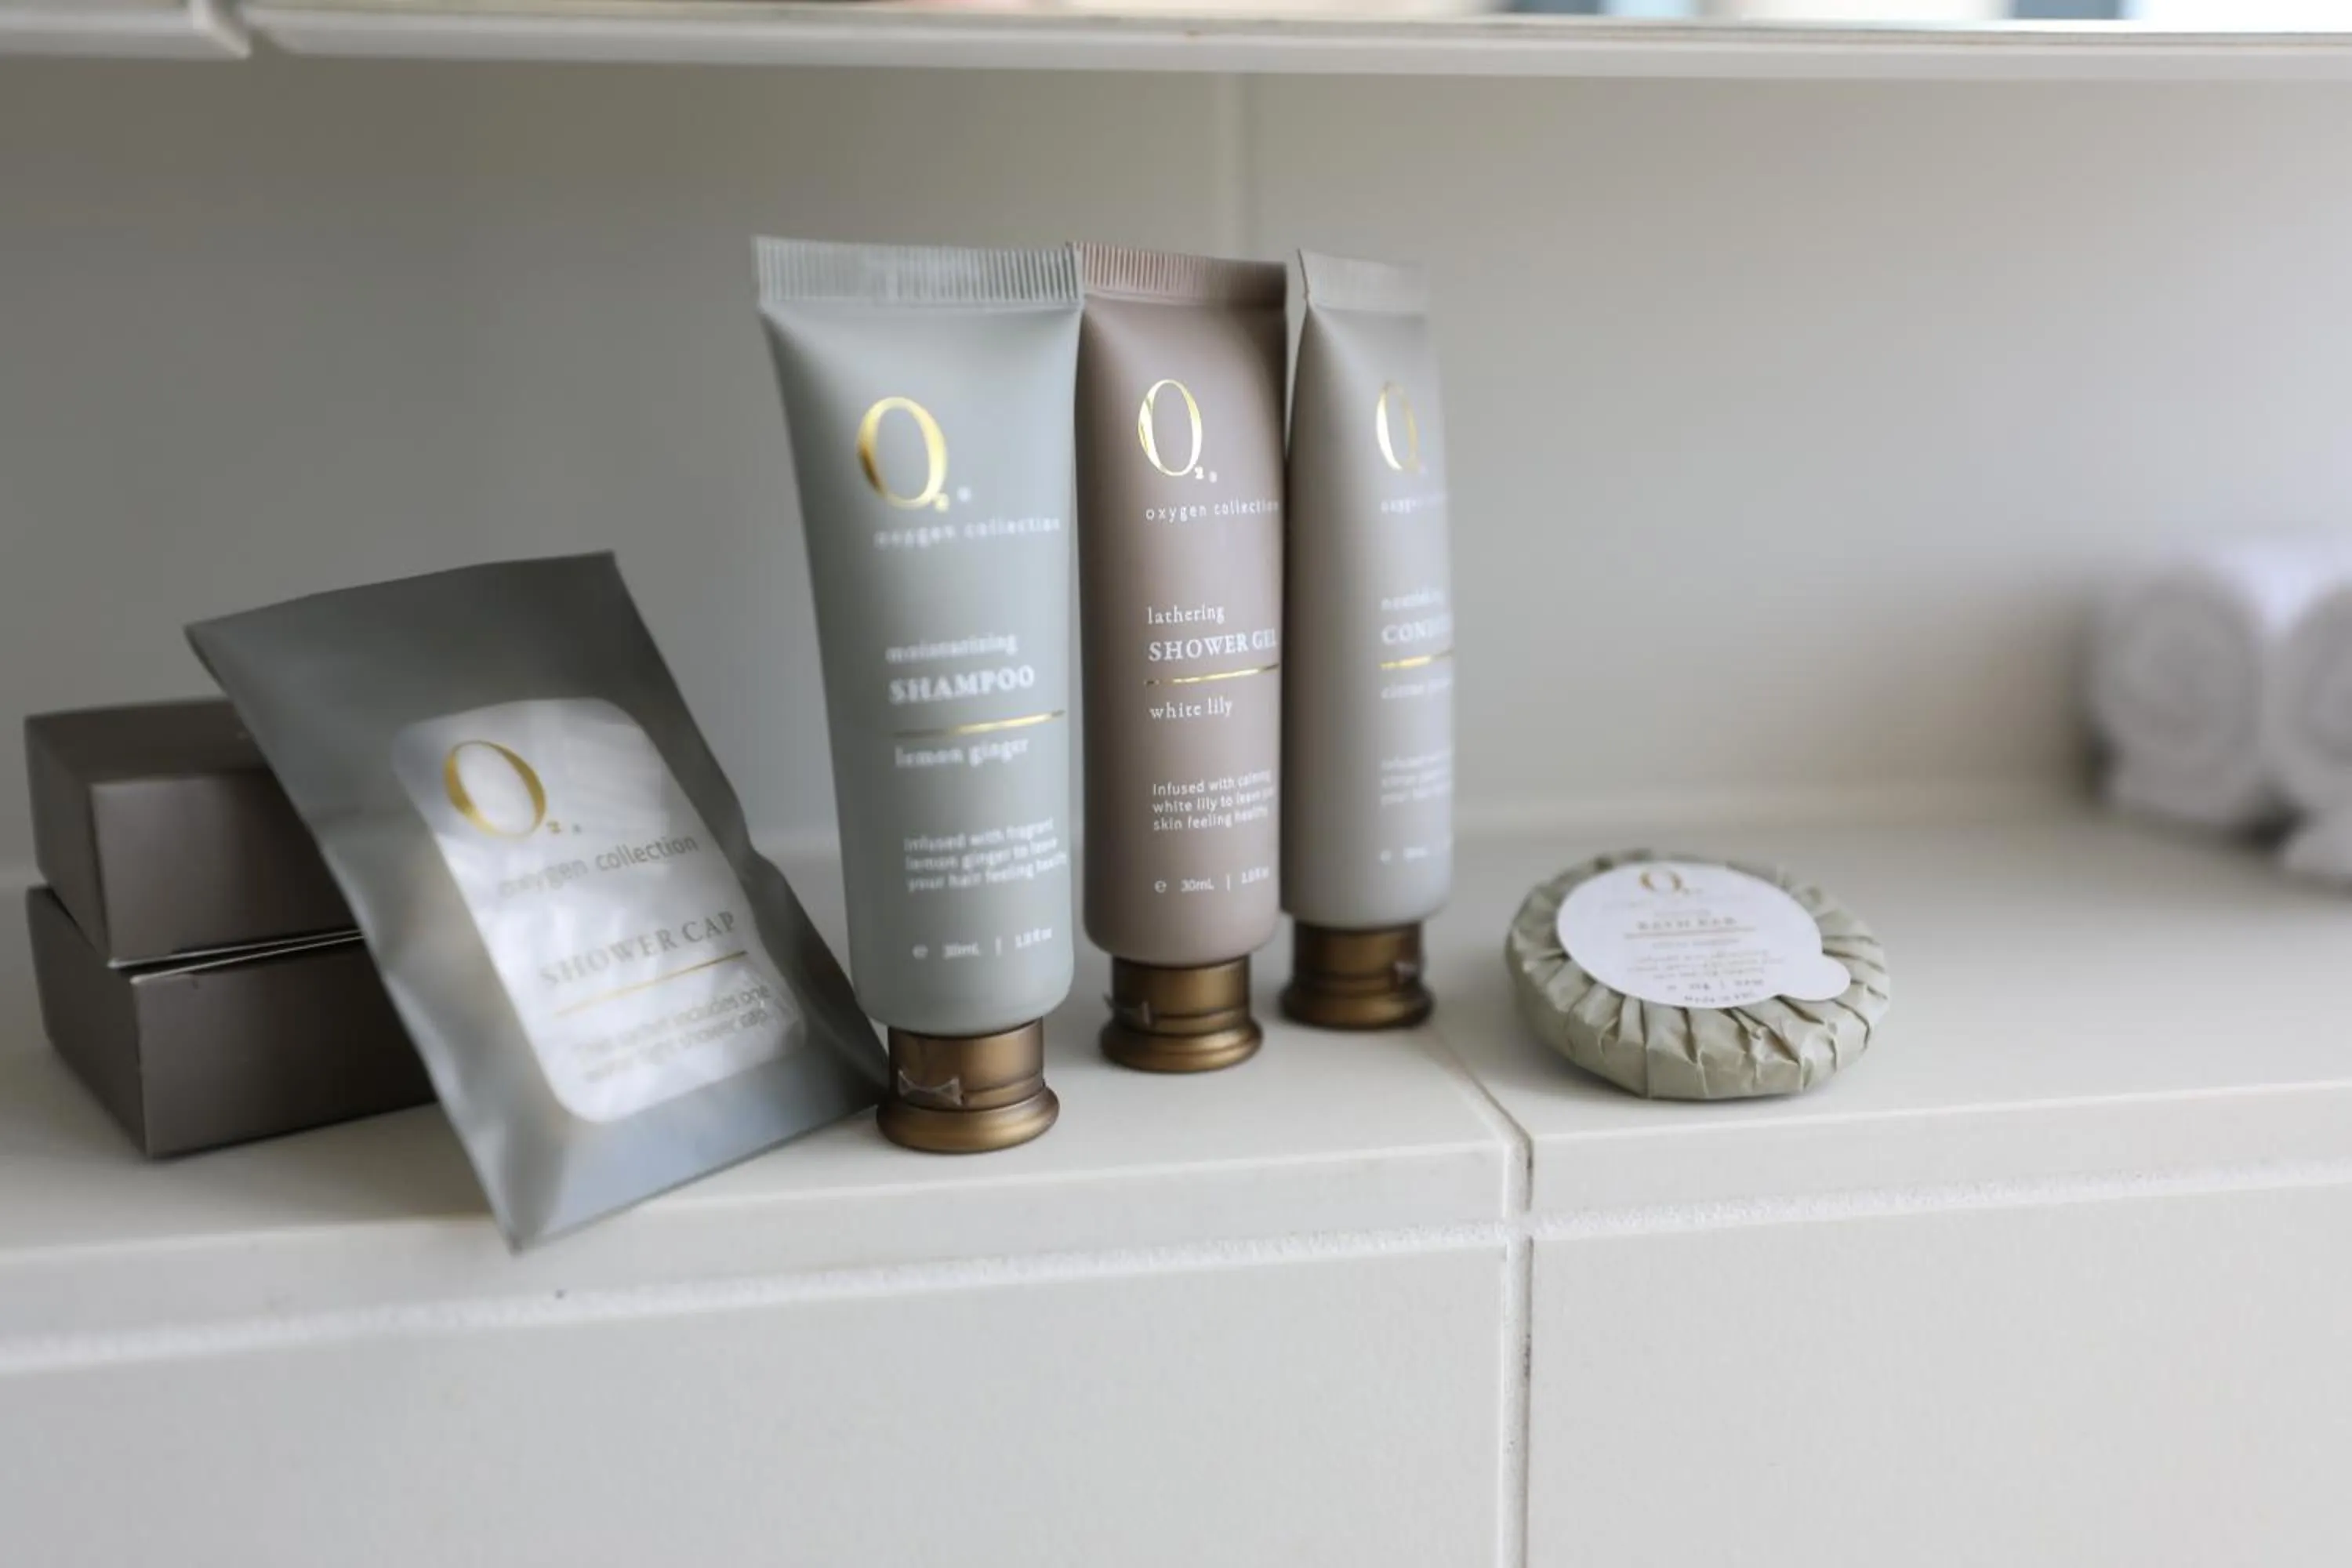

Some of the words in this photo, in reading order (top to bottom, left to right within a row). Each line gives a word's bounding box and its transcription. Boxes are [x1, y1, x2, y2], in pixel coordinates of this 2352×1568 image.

[1145, 505, 1207, 523] oxygen
[1214, 497, 1280, 515] collection
[1148, 603, 1225, 625] lathering
[1149, 632, 1249, 662] SHOWER
[889, 665, 1035, 704] SHAMPOO
[1149, 702, 1202, 719] white
[1207, 696, 1233, 717] lily
[895, 746, 964, 768] lemon
[968, 739, 1029, 768] ginger
[1152, 779, 1205, 797] Infused
[1208, 775, 1236, 791] with
[1152, 800, 1193, 814] white
[1197, 797, 1218, 813] lily
[1221, 795, 1233, 808] to
[1152, 818, 1183, 832] skin
[1188, 813, 1233, 829] feeling
[593, 836, 699, 872] collection
[539, 928, 679, 985] SHOWER
[681, 910, 737, 946] CAP
